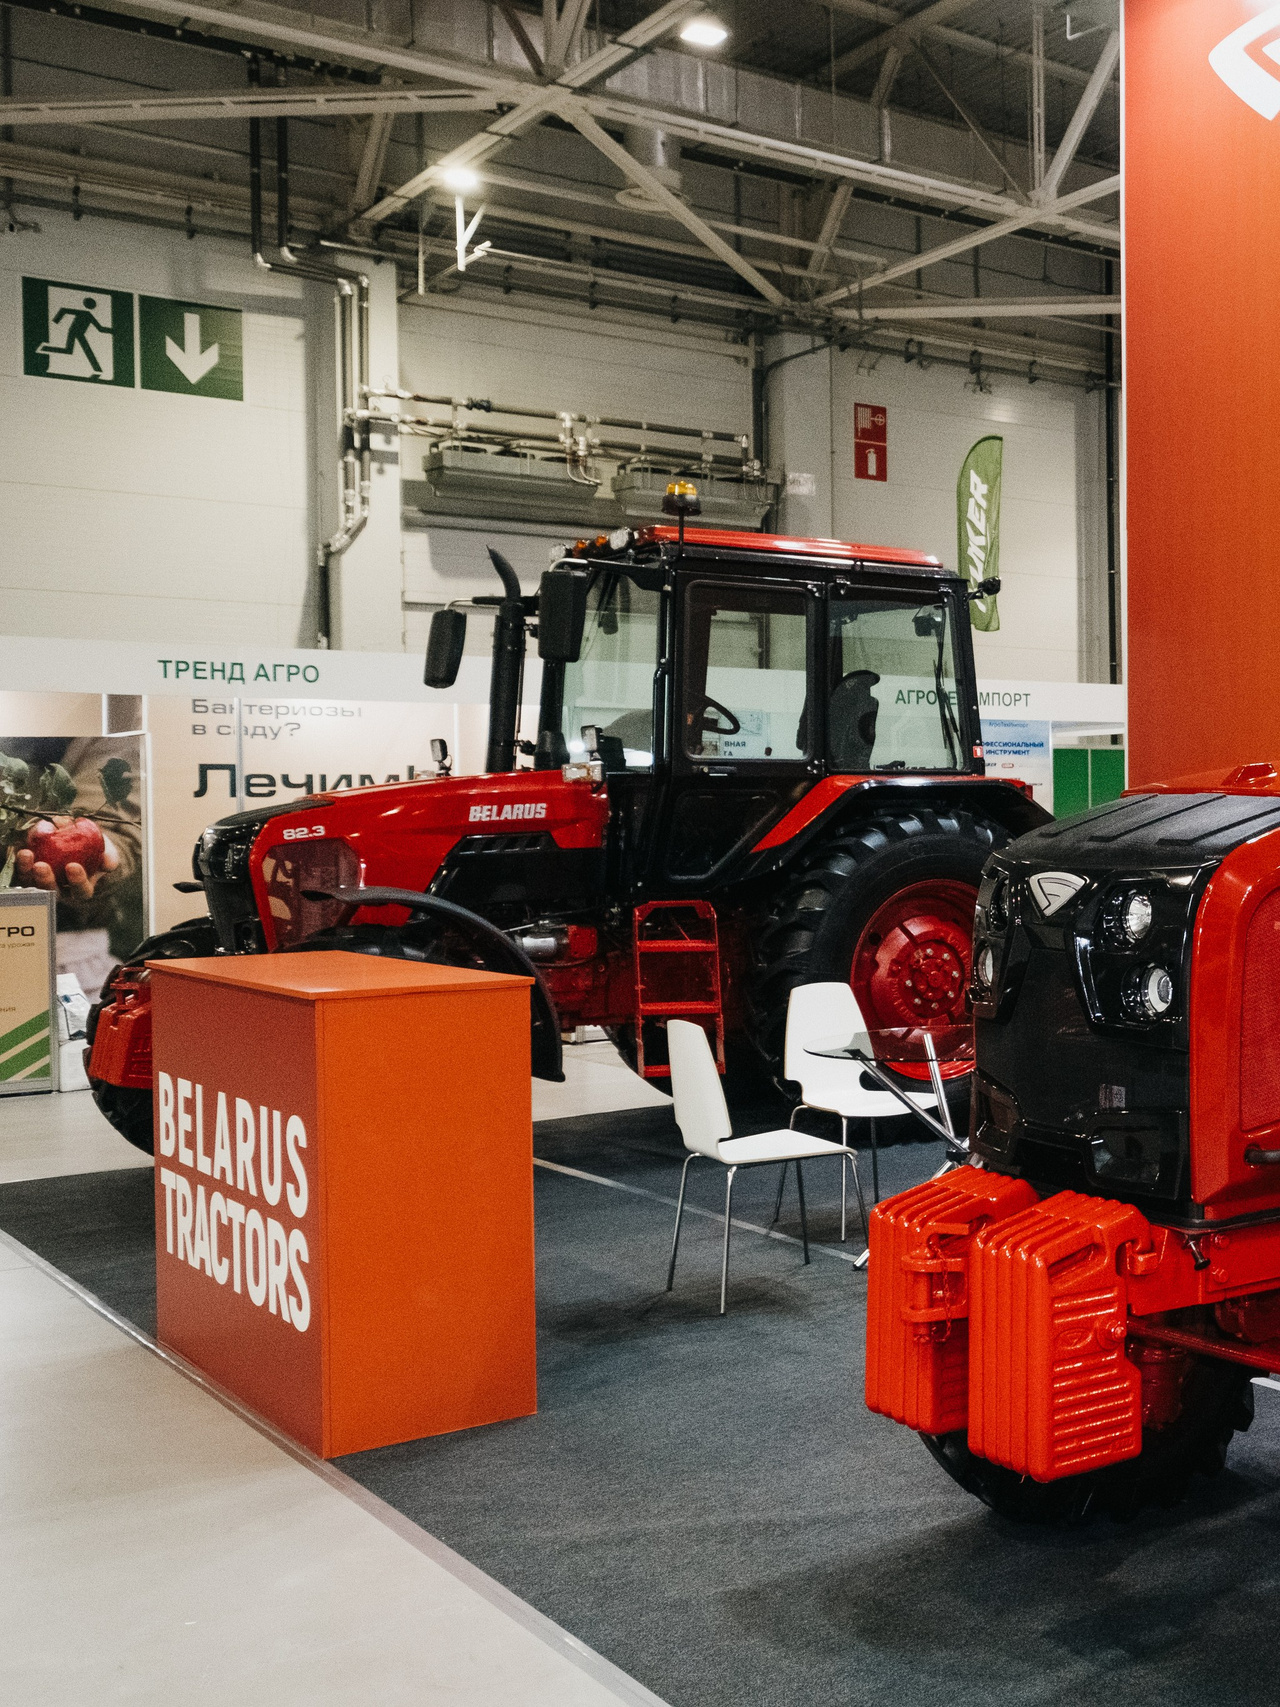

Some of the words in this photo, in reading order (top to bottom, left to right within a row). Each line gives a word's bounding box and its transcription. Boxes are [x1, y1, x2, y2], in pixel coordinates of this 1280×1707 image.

[158, 659, 245, 685] ТРЕНД
[254, 663, 320, 683] АГРО
[895, 689, 1030, 707] АГРОЕМПОРТ
[192, 724, 206, 735] в
[469, 803, 547, 822] BELARUS
[283, 825, 325, 840] 82.3
[158, 1071, 309, 1218] BELARUS
[161, 1167, 311, 1332] TRACTORS
